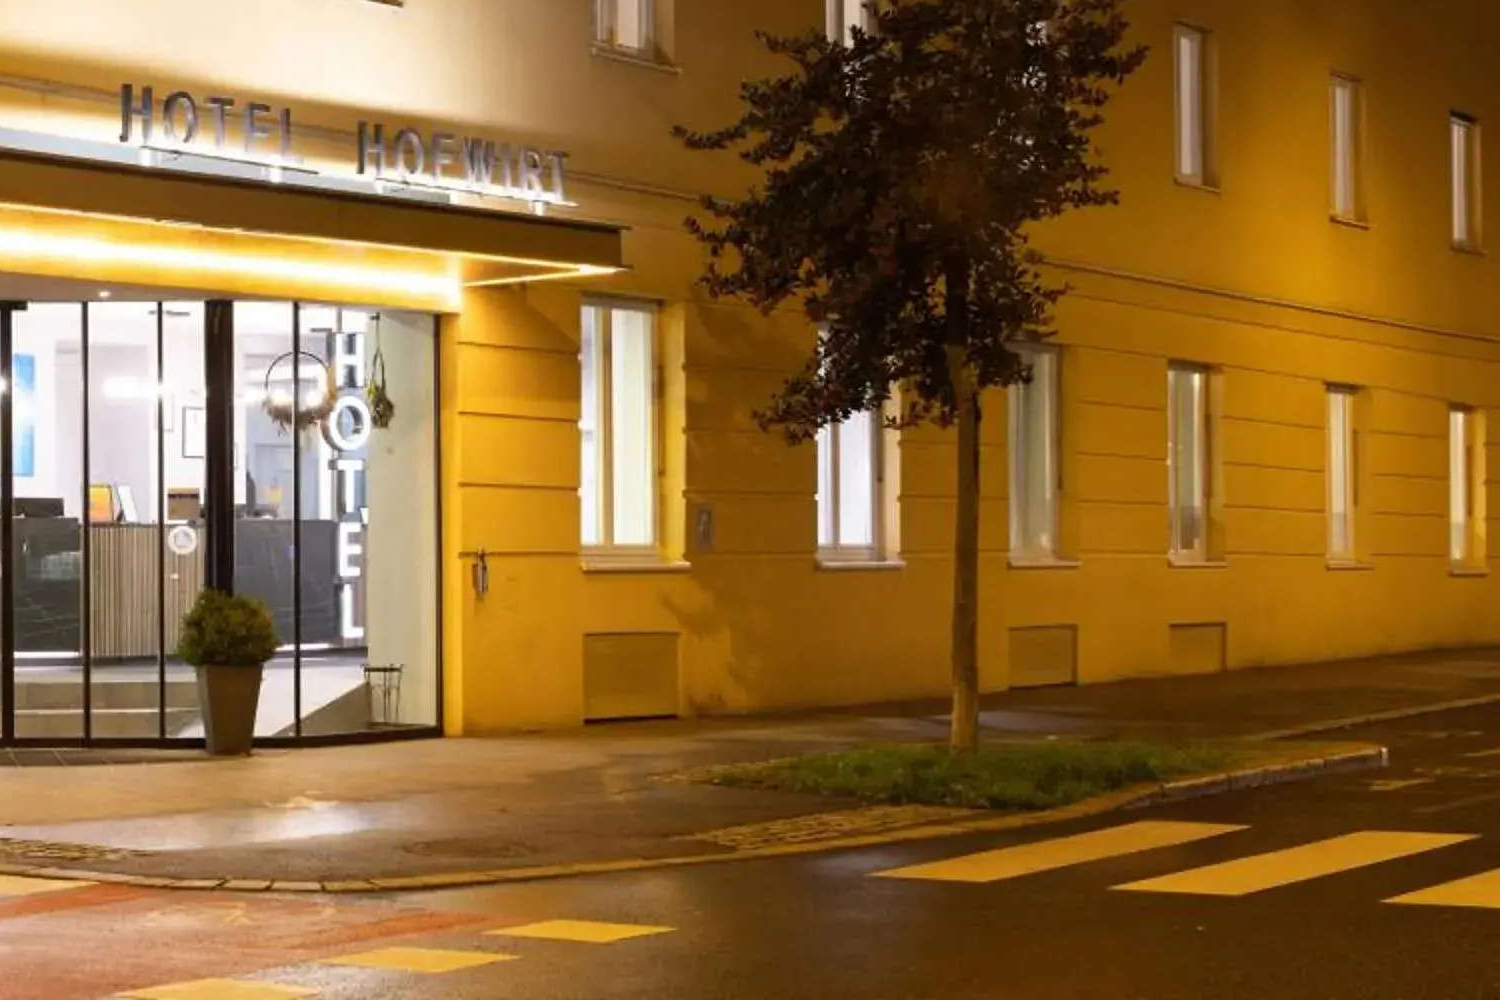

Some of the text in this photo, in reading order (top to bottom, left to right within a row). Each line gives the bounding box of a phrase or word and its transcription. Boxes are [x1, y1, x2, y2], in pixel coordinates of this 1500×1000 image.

[119, 83, 571, 205] HOTEL HOFWIRT
[327, 331, 373, 640] HOTEL
